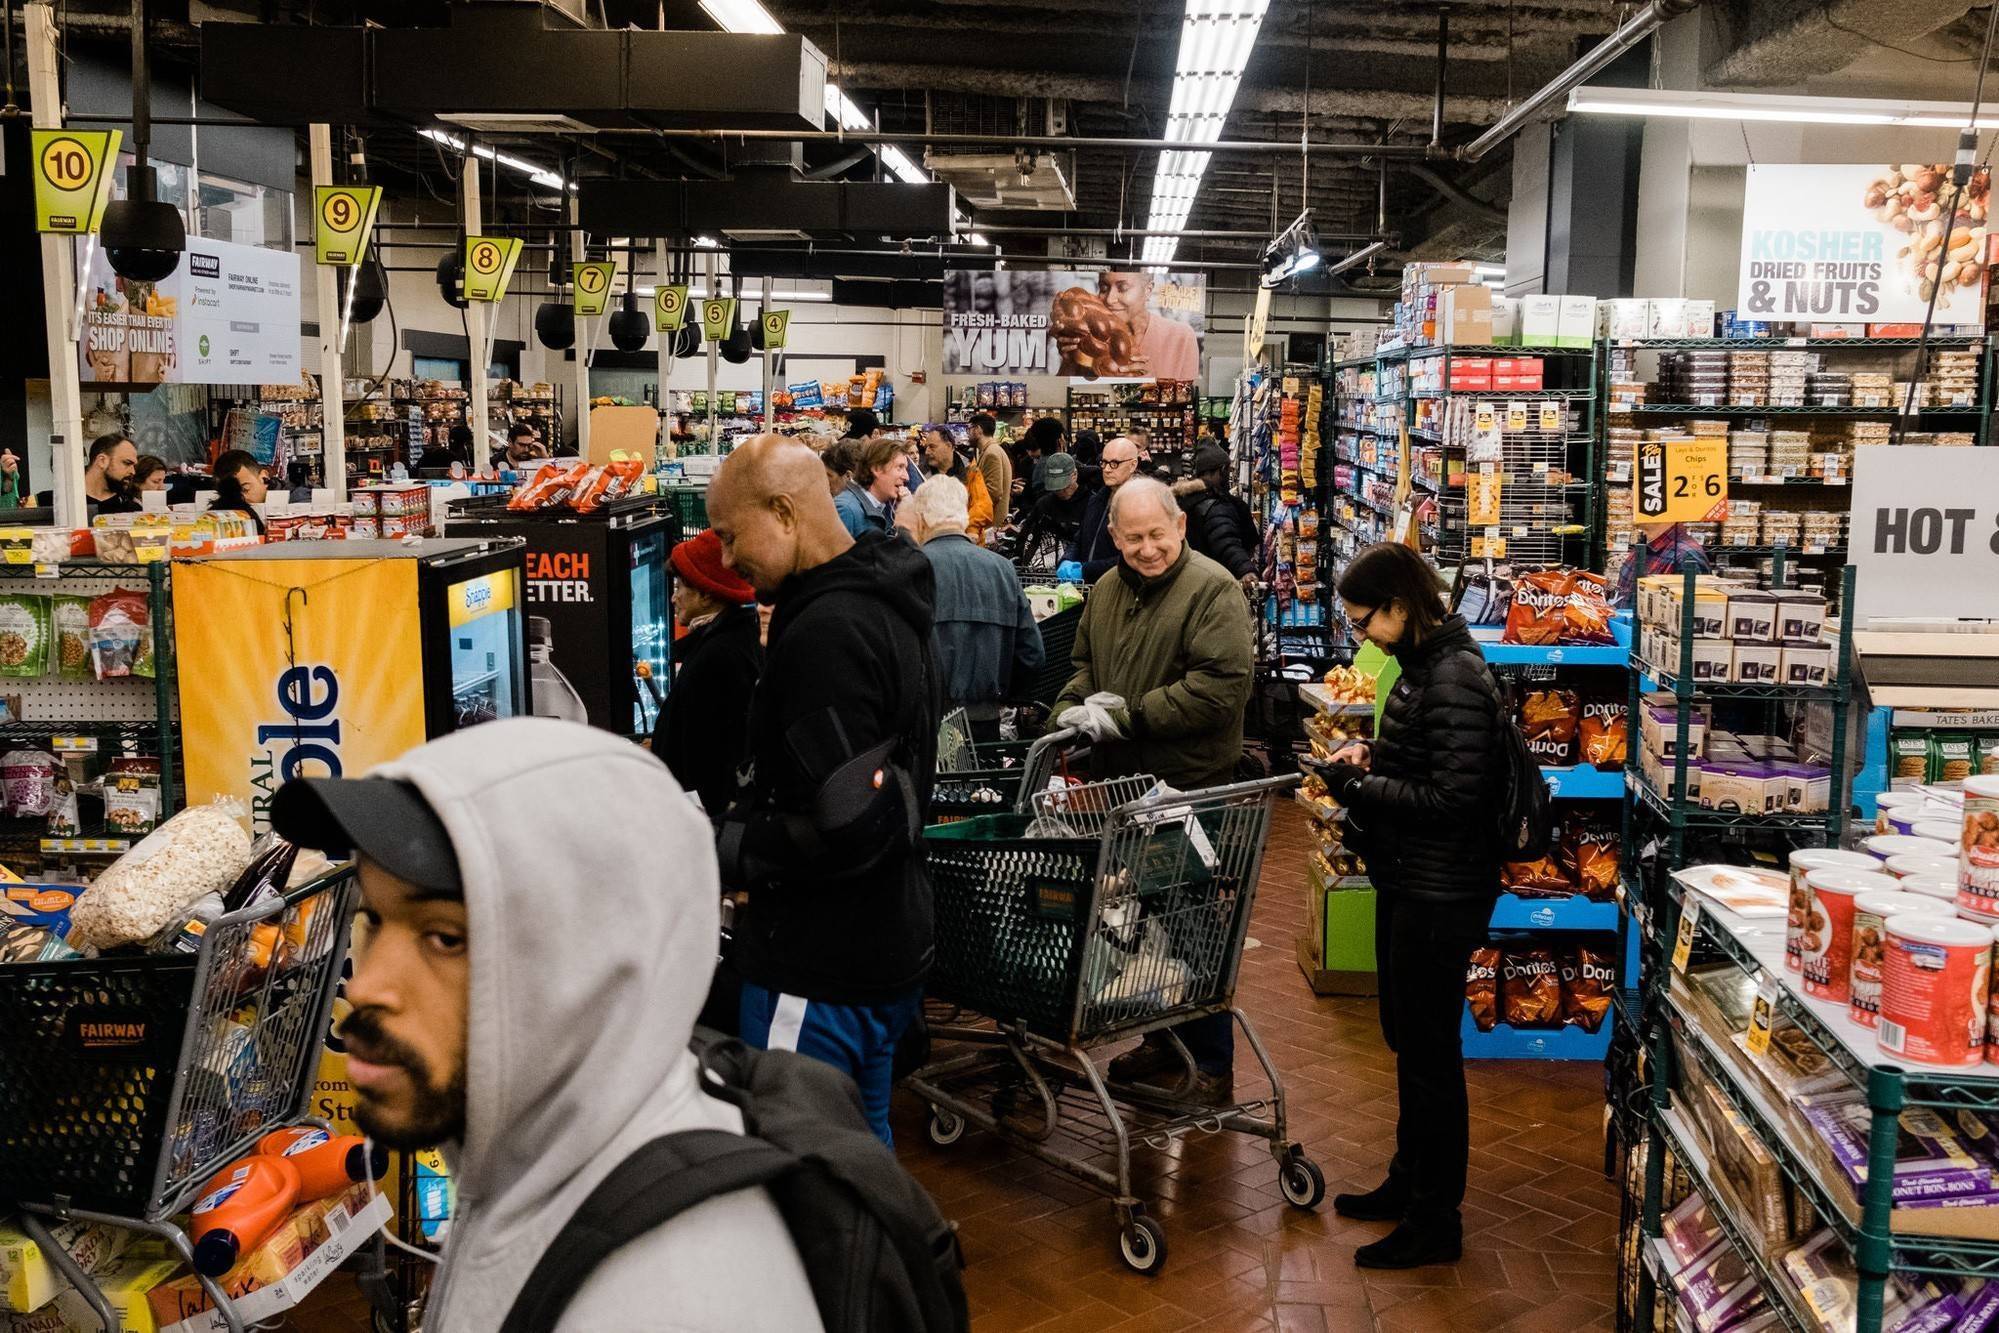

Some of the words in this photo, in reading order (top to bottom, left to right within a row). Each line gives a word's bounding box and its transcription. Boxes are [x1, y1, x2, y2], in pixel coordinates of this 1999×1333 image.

[50, 151, 84, 180] 10
[332, 199, 350, 225] 9
[1751, 230, 1885, 261] KOSHER
[192, 256, 218, 270] FAIRWAY
[478, 247, 493, 268] 8
[585, 272, 598, 289] 7
[1750, 262, 1806, 281] DRIED
[1814, 262, 1881, 281] FRUITS
[664, 294, 674, 309] 6
[1747, 280, 1777, 313] &
[1783, 280, 1880, 315] NUTS
[88, 311, 103, 323] IT'S
[104, 313, 128, 326] EASIER
[129, 315, 146, 327] THAN
[147, 316, 164, 328] EVER
[164, 317, 174, 329] TO
[710, 308, 720, 321] 5
[769, 317, 777, 330] 4
[951, 313, 1048, 328] FRESH-BAKED
[89, 327, 126, 352] SHOP
[129, 329, 175, 354] ONLINE
[950, 327, 1048, 369] YUM
[1641, 444, 1662, 458] Big
[1685, 456, 1707, 464] Chips
[1643, 455, 1663, 512] SALE
[1673, 475, 1690, 498] 2
[1873, 507, 1976, 555] HOT
[527, 553, 590, 579] EACH
[1517, 587, 1571, 608] Doritos
[1503, 960, 1557, 981] Doritos
[80, 1023, 146, 1039] FAIRWAY
[1923, 1181, 1976, 1194] BON-BONS
